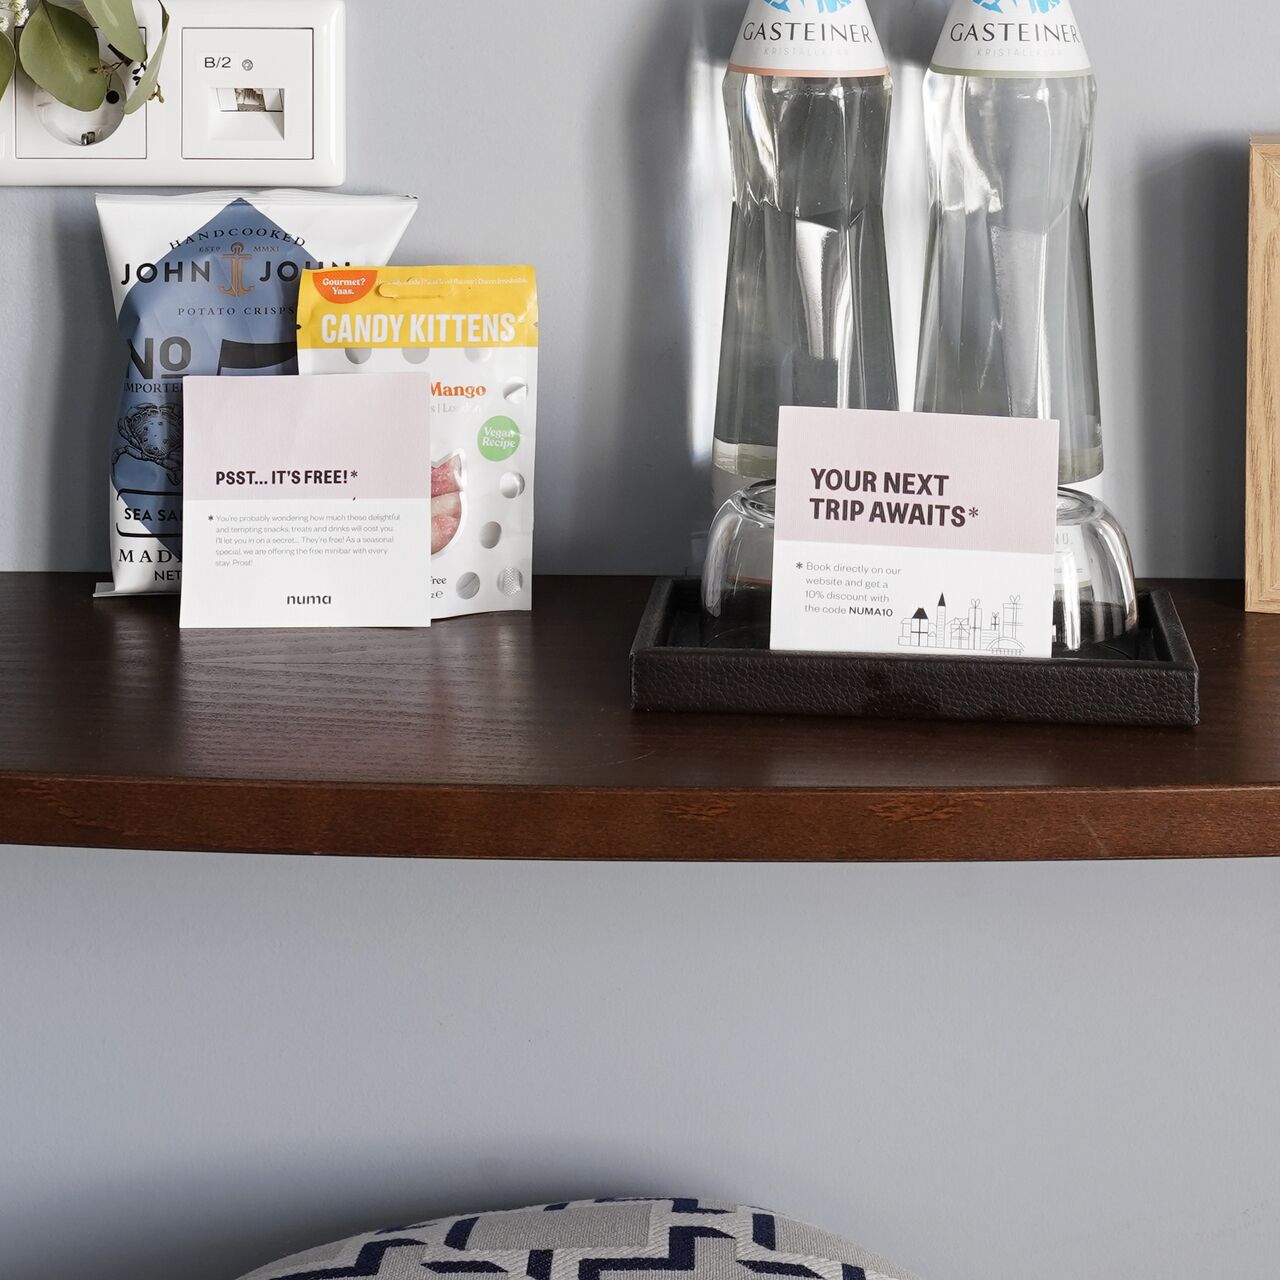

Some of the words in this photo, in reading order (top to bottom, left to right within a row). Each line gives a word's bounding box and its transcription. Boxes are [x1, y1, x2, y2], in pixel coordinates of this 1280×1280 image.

[743, 21, 872, 44] GASTEINER
[950, 21, 1080, 44] GASTEINER
[204, 56, 231, 68] B/2
[169, 228, 306, 250] HANDCOOKED
[121, 261, 210, 285] JOHN
[260, 261, 350, 281] JO
[322, 278, 366, 286] Gourmet?
[332, 286, 355, 295] Yaas.
[178, 307, 236, 316] POTATO
[243, 306, 295, 315] CRISPS
[321, 313, 404, 343] CANDY
[410, 312, 516, 343] KITTENS
[124, 382, 183, 393] MPORTE
[431, 381, 487, 399] Mango
[484, 427, 514, 440] Vegan
[481, 436, 516, 449] Recipe
[215, 470, 268, 485] PSST...
[271, 470, 301, 484] IT'S
[810, 468, 877, 493] YOUR
[883, 472, 950, 496] NEXT
[124, 508, 153, 521] SEA
[809, 498, 865, 522] TRIP
[119, 549, 182, 563] MAD
[806, 562, 831, 572] Book
[832, 563, 869, 574] directly
[884, 567, 901, 575] our
[154, 570, 182, 581] NET
[430, 575, 447, 585] ree
[806, 575, 843, 586] website
[844, 577, 863, 587] and
[864, 578, 881, 589] get
[286, 594, 332, 605] numa
[805, 589, 825, 599] 10%
[825, 590, 867, 601] discount
[869, 592, 890, 602] with
[804, 603, 820, 613] the
[821, 604, 847, 614] code
[848, 605, 893, 617] NUMA10
